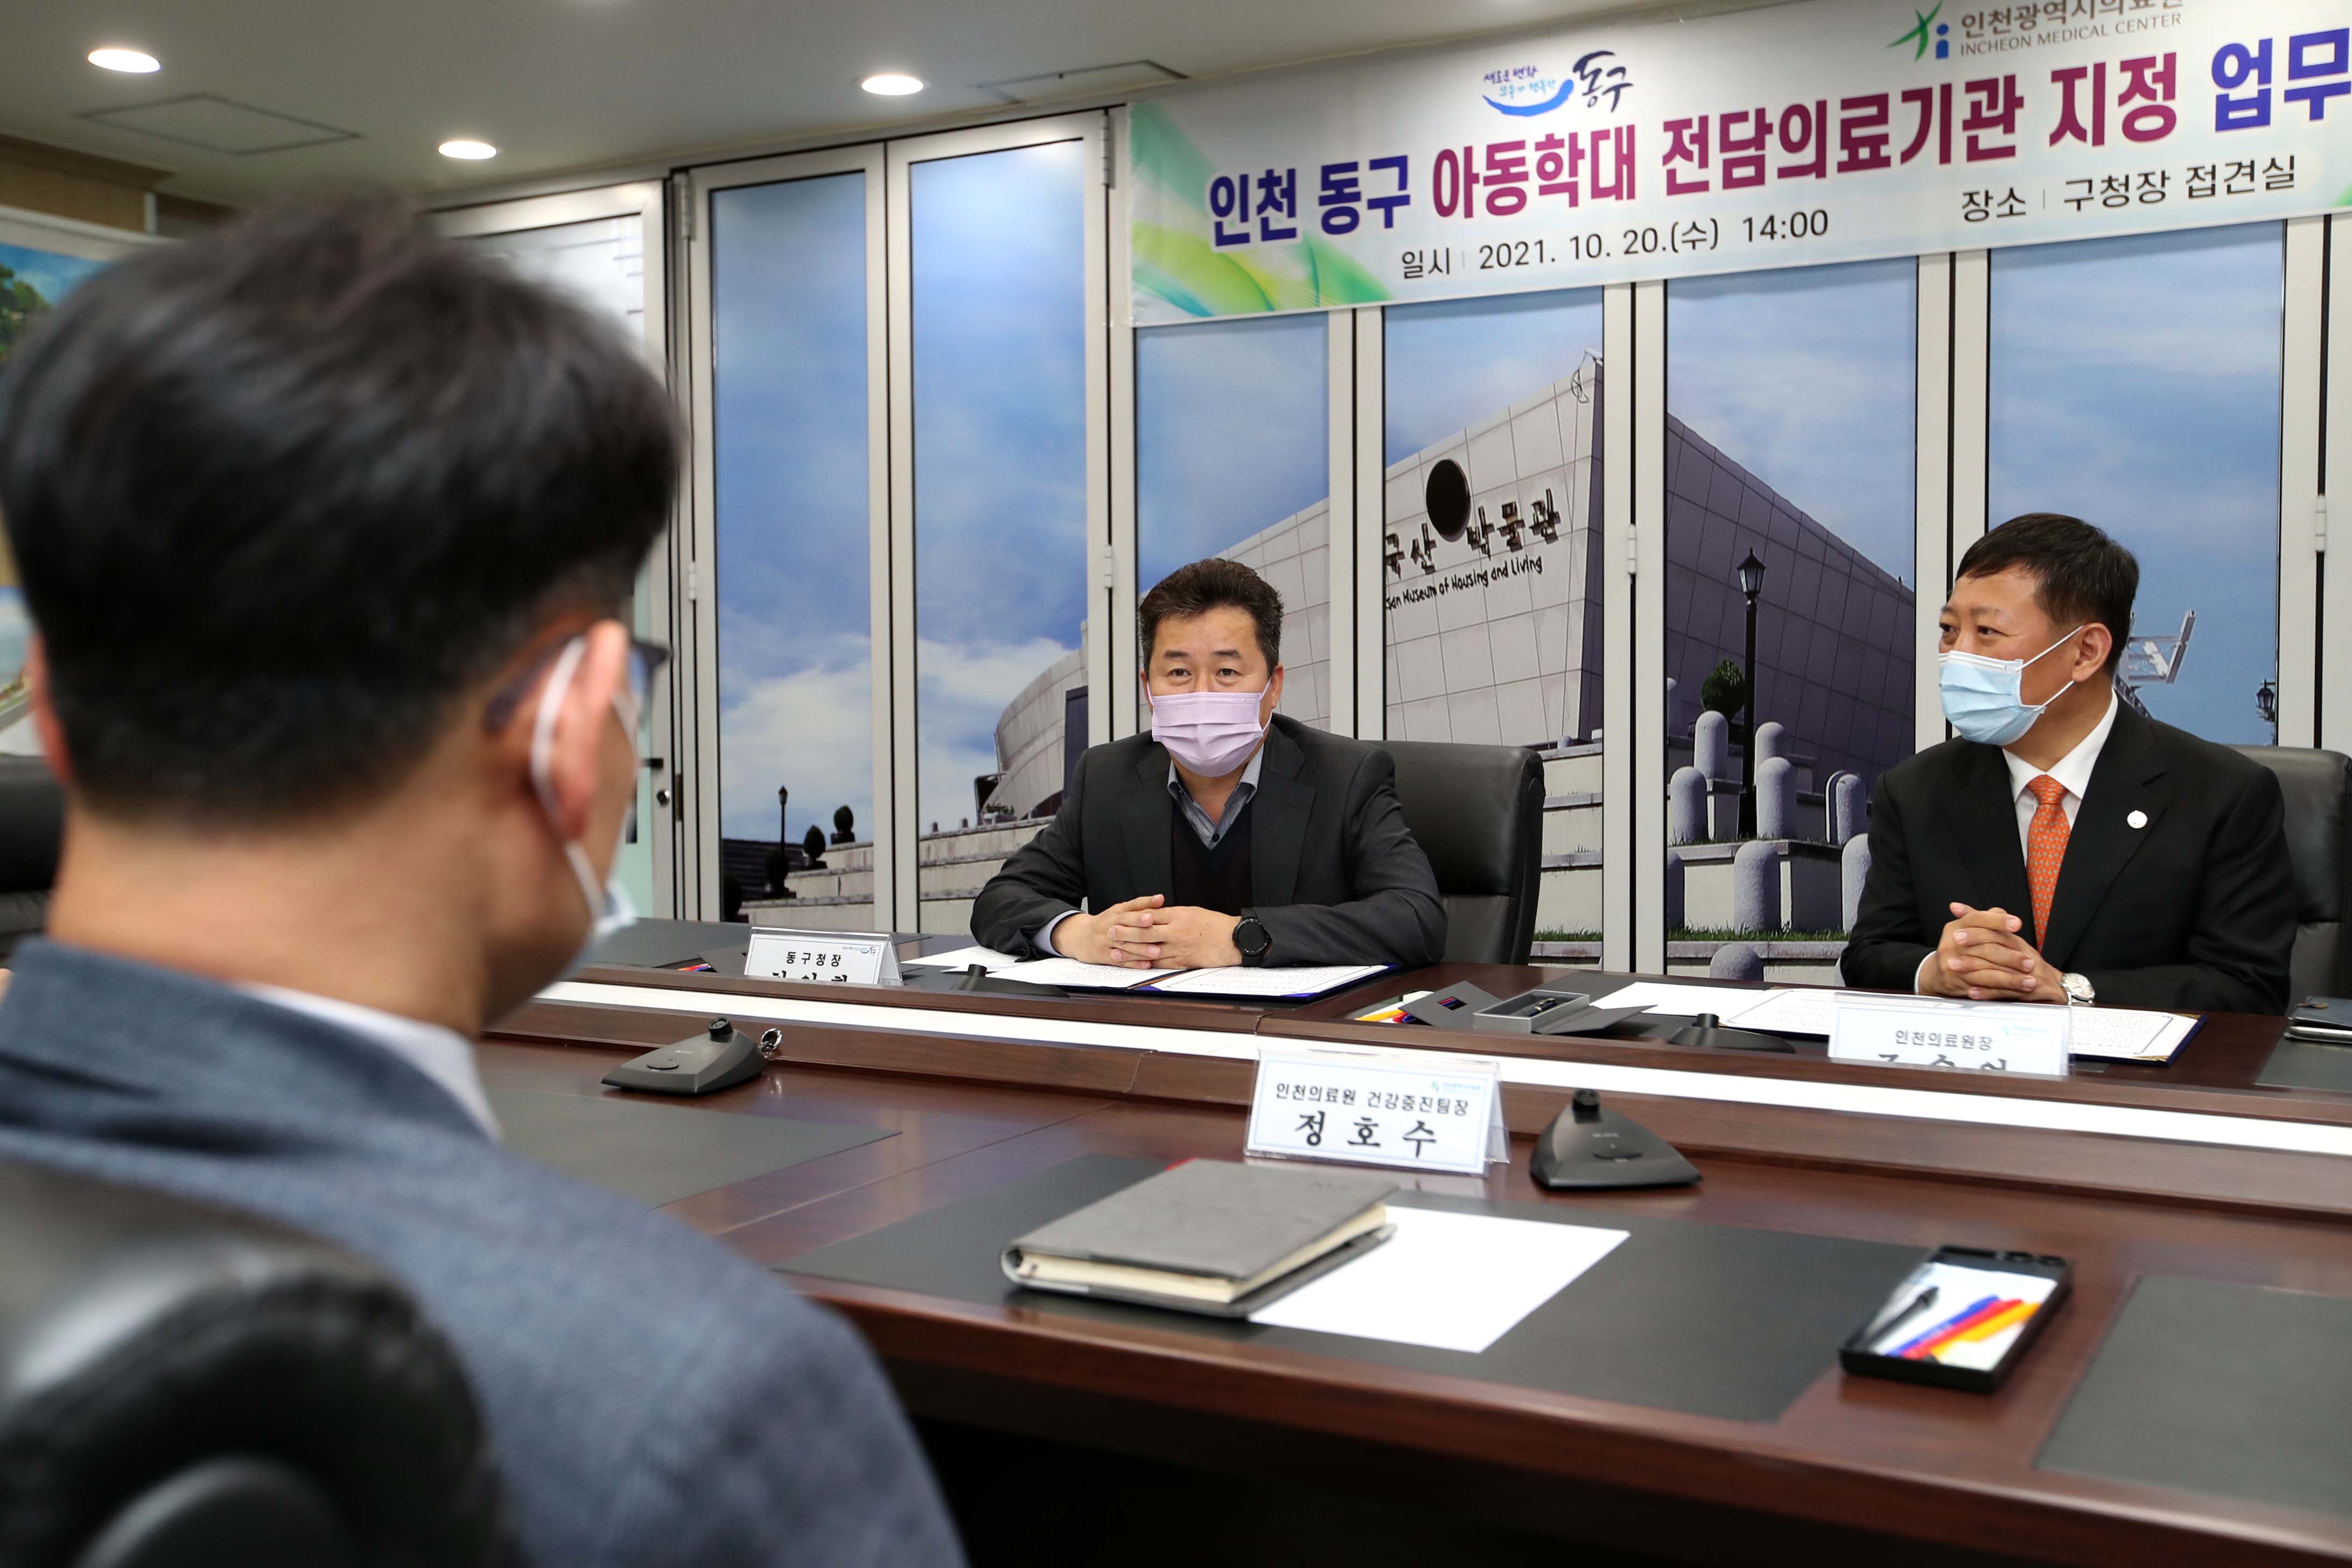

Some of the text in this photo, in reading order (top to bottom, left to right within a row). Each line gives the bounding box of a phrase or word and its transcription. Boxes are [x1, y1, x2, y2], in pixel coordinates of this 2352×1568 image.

[1961, 13, 2182, 57] INCHEON MEDICAL CENTER
[1573, 51, 1633, 112] 동구
[1210, 27, 2351, 247] 인천 동구 아동학대 전담의료기관 지정 업무
[1962, 155, 2295, 222] 장소 구청장 접견실
[1402, 209, 1828, 279] 일시 2021. 10. 20.(수) 14:00
[1402, 585, 1437, 605] Museum
[1439, 578, 1450, 595] of
[1451, 569, 1488, 587] Housing
[1491, 560, 1508, 581] and
[1511, 554, 1543, 575] Living
[786, 951, 842, 967] 동구청장
[1895, 1030, 1993, 1051] 인천의료원장
[1276, 1082, 1469, 1116] 인천의료원 건강증진팀장
